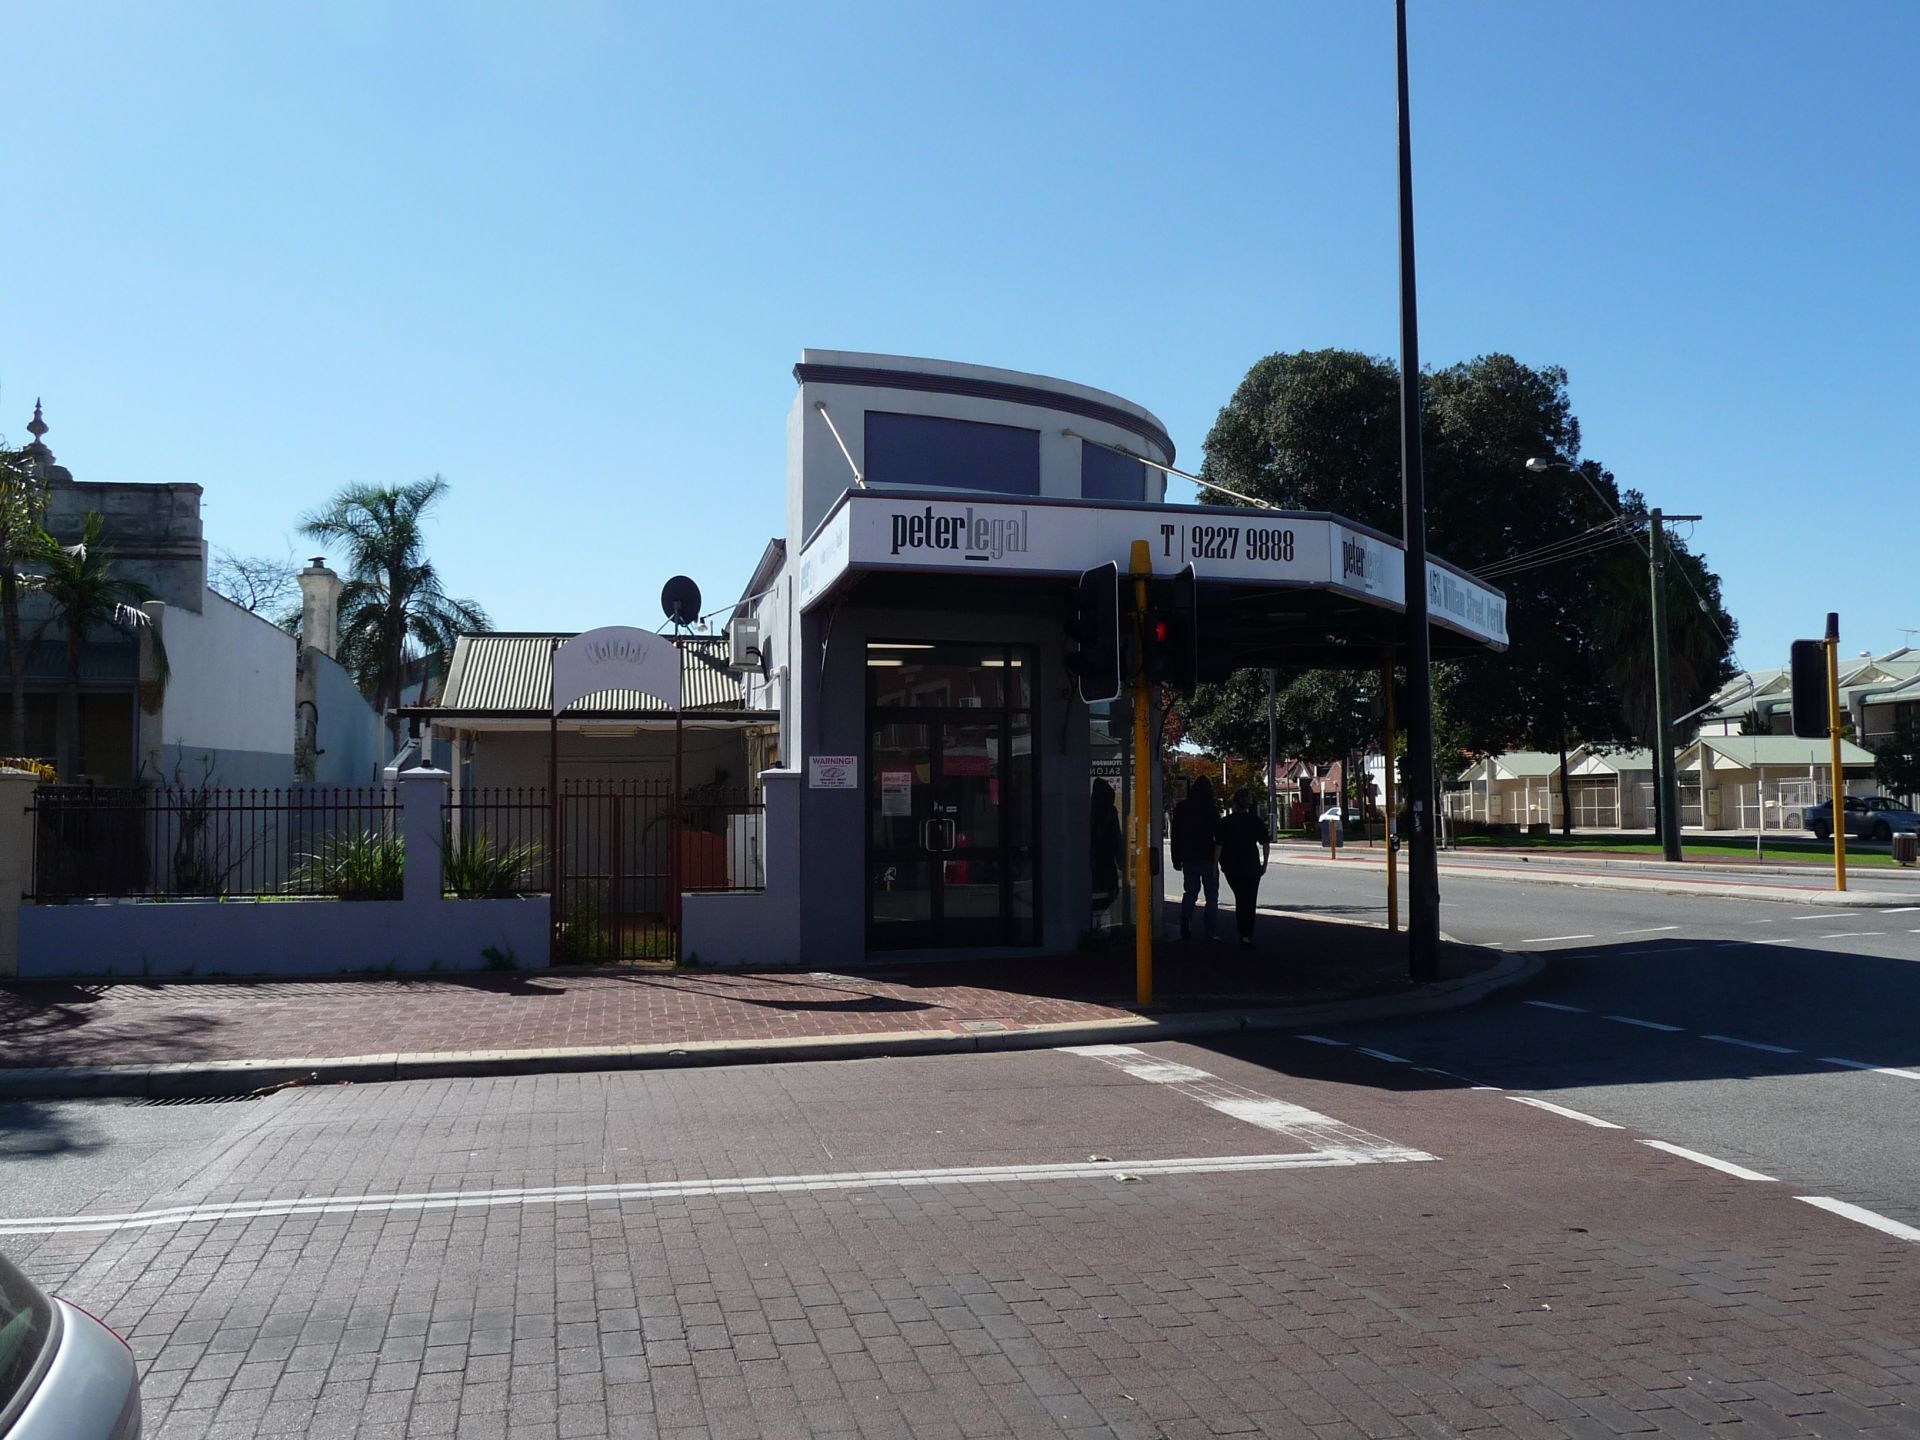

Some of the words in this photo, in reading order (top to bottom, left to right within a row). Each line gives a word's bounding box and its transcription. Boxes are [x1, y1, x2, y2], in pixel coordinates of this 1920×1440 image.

[1192, 525, 1239, 559] 9227
[1246, 528, 1295, 562] 9888
[812, 757, 854, 765] WARNING!
